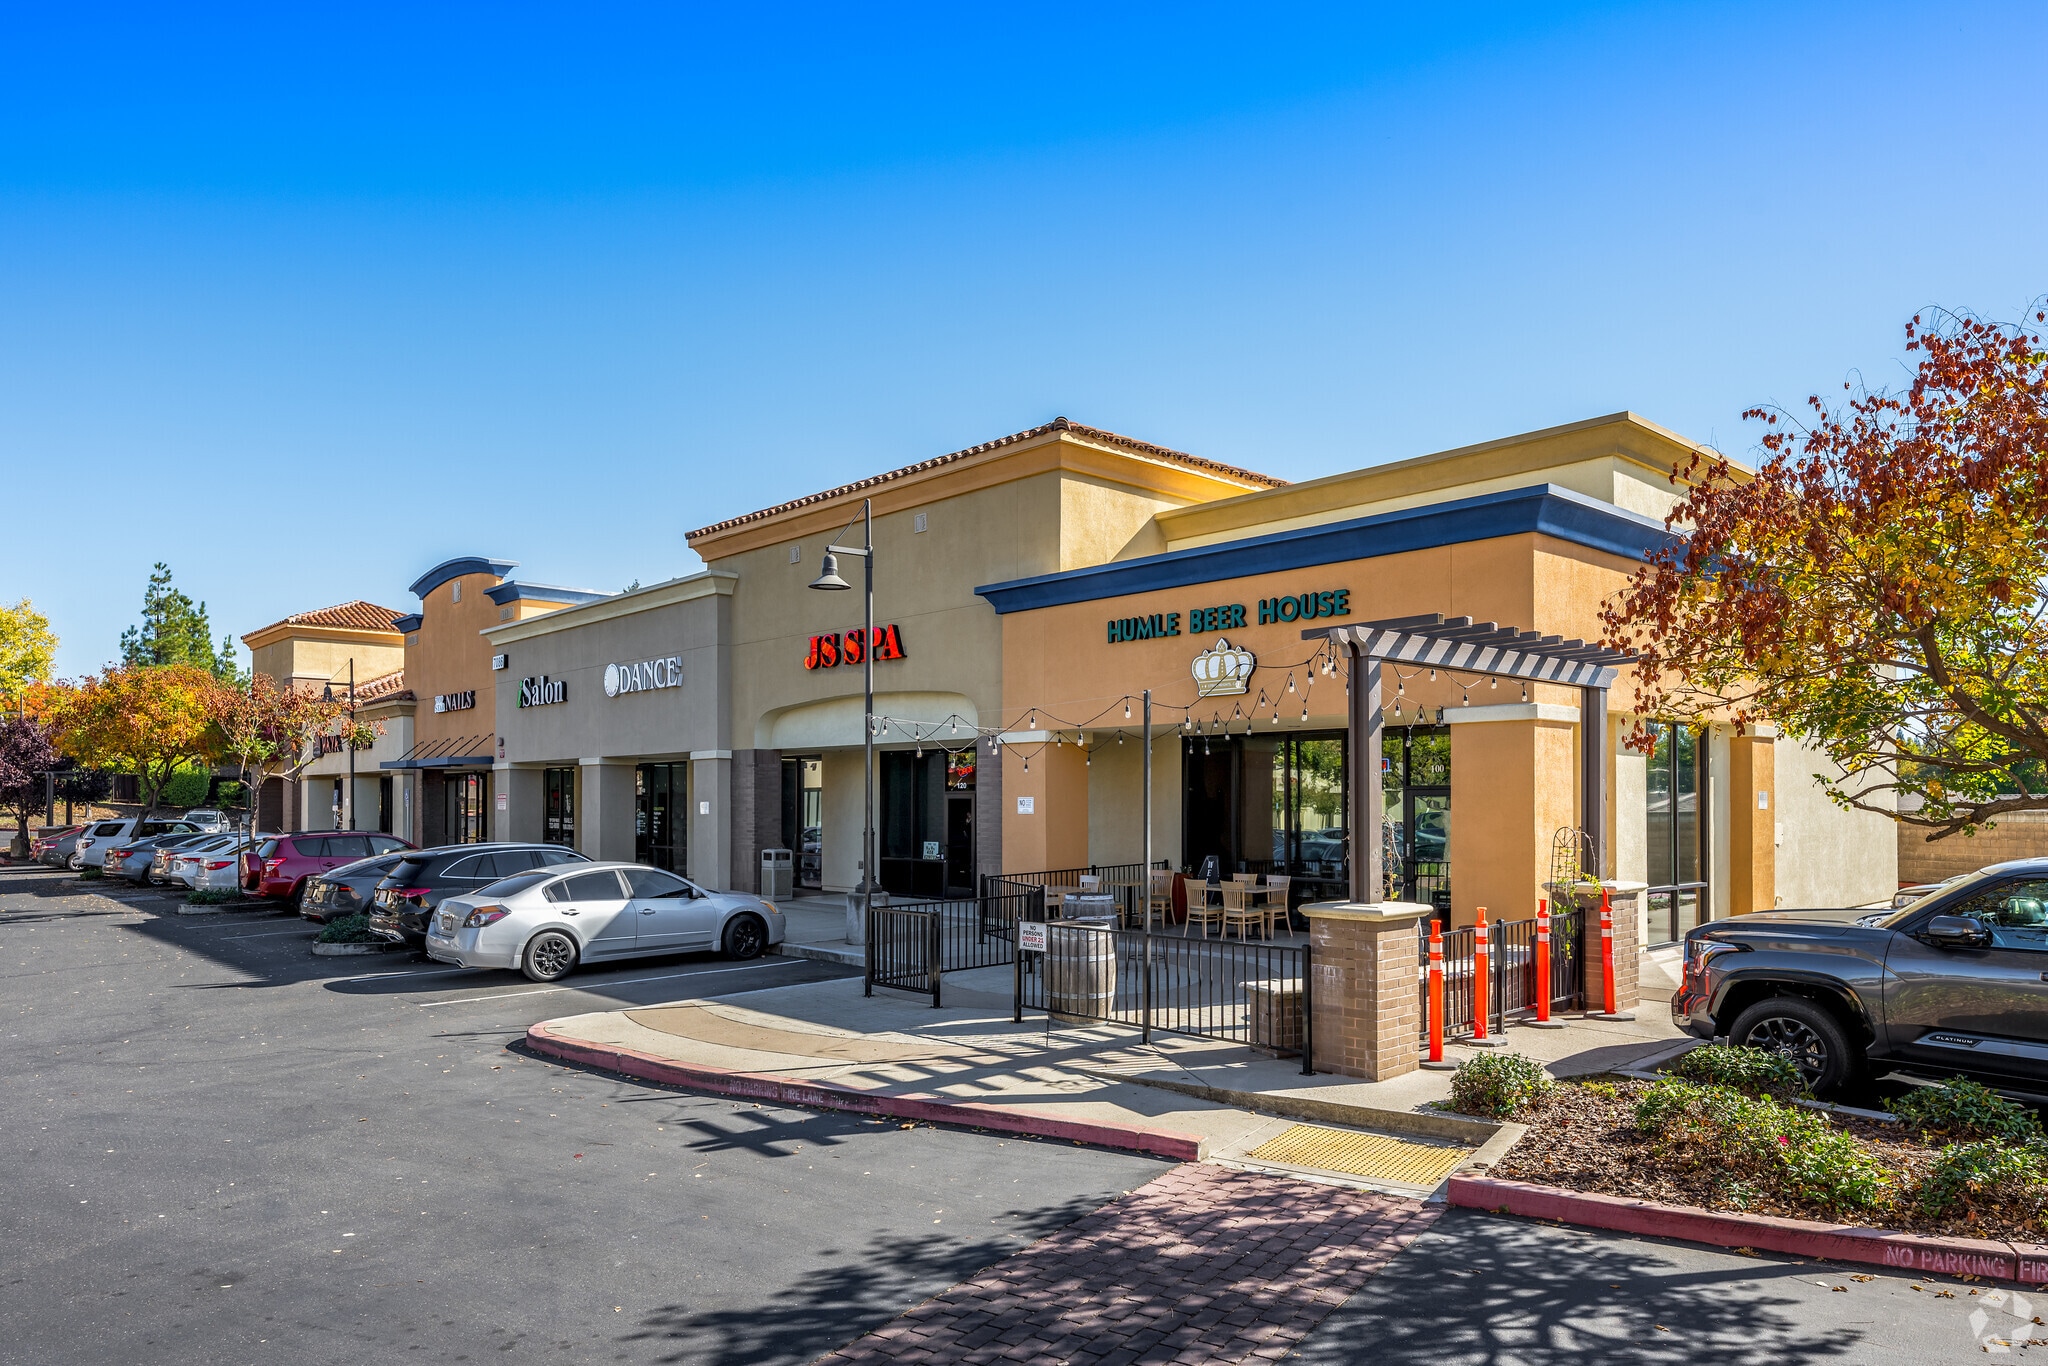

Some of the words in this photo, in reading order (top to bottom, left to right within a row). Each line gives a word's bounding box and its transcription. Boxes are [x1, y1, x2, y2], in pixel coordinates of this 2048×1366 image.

[1108, 613, 1181, 643] HUMLE
[1190, 604, 1247, 633] BEER
[1258, 589, 1350, 625] HOUSE
[804, 633, 840, 670] JS
[843, 623, 906, 665] SPA
[619, 656, 682, 694] DANCE
[446, 690, 474, 712] NAILS
[516, 676, 567, 709] iSalon
[1431, 765, 1445, 773] 100
[1936, 1035, 1973, 1044] PLATINUM
[730, 1079, 742, 1092] NO
[782, 1087, 801, 1101] FIRE
[803, 1091, 824, 1104] LANE
[1886, 1245, 1915, 1268] NO
[1921, 1250, 2006, 1278] PARKING
